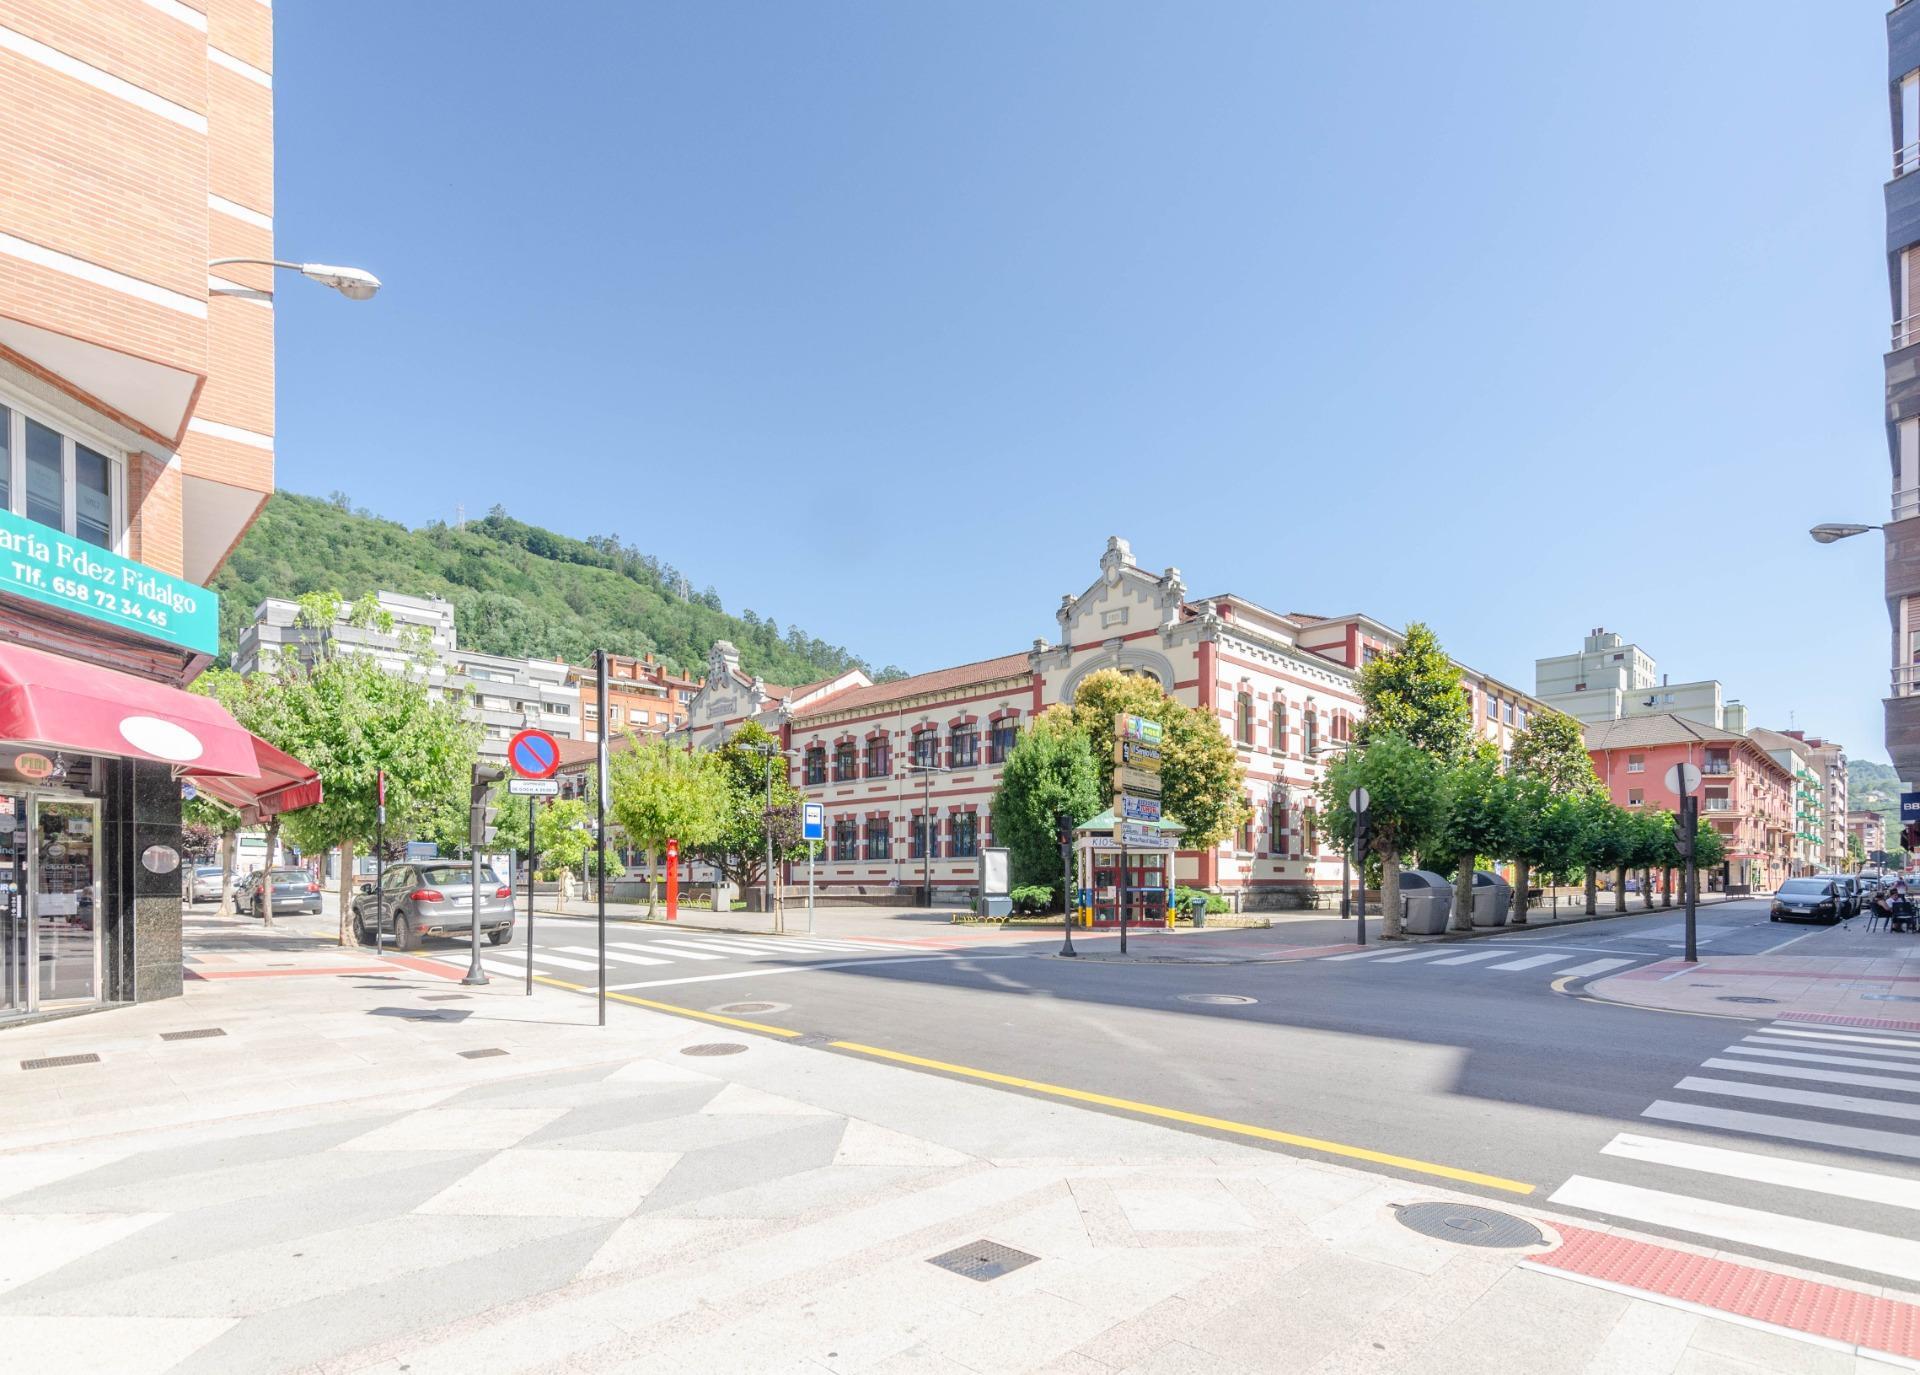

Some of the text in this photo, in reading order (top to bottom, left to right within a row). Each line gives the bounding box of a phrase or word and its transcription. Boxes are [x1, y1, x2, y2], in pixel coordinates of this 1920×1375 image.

[12, 561, 168, 627] Tlf. 658 72 34 45
[56, 542, 116, 585] Fdez
[121, 566, 197, 614] Fidalgo
[1092, 838, 1115, 846] KIOS
